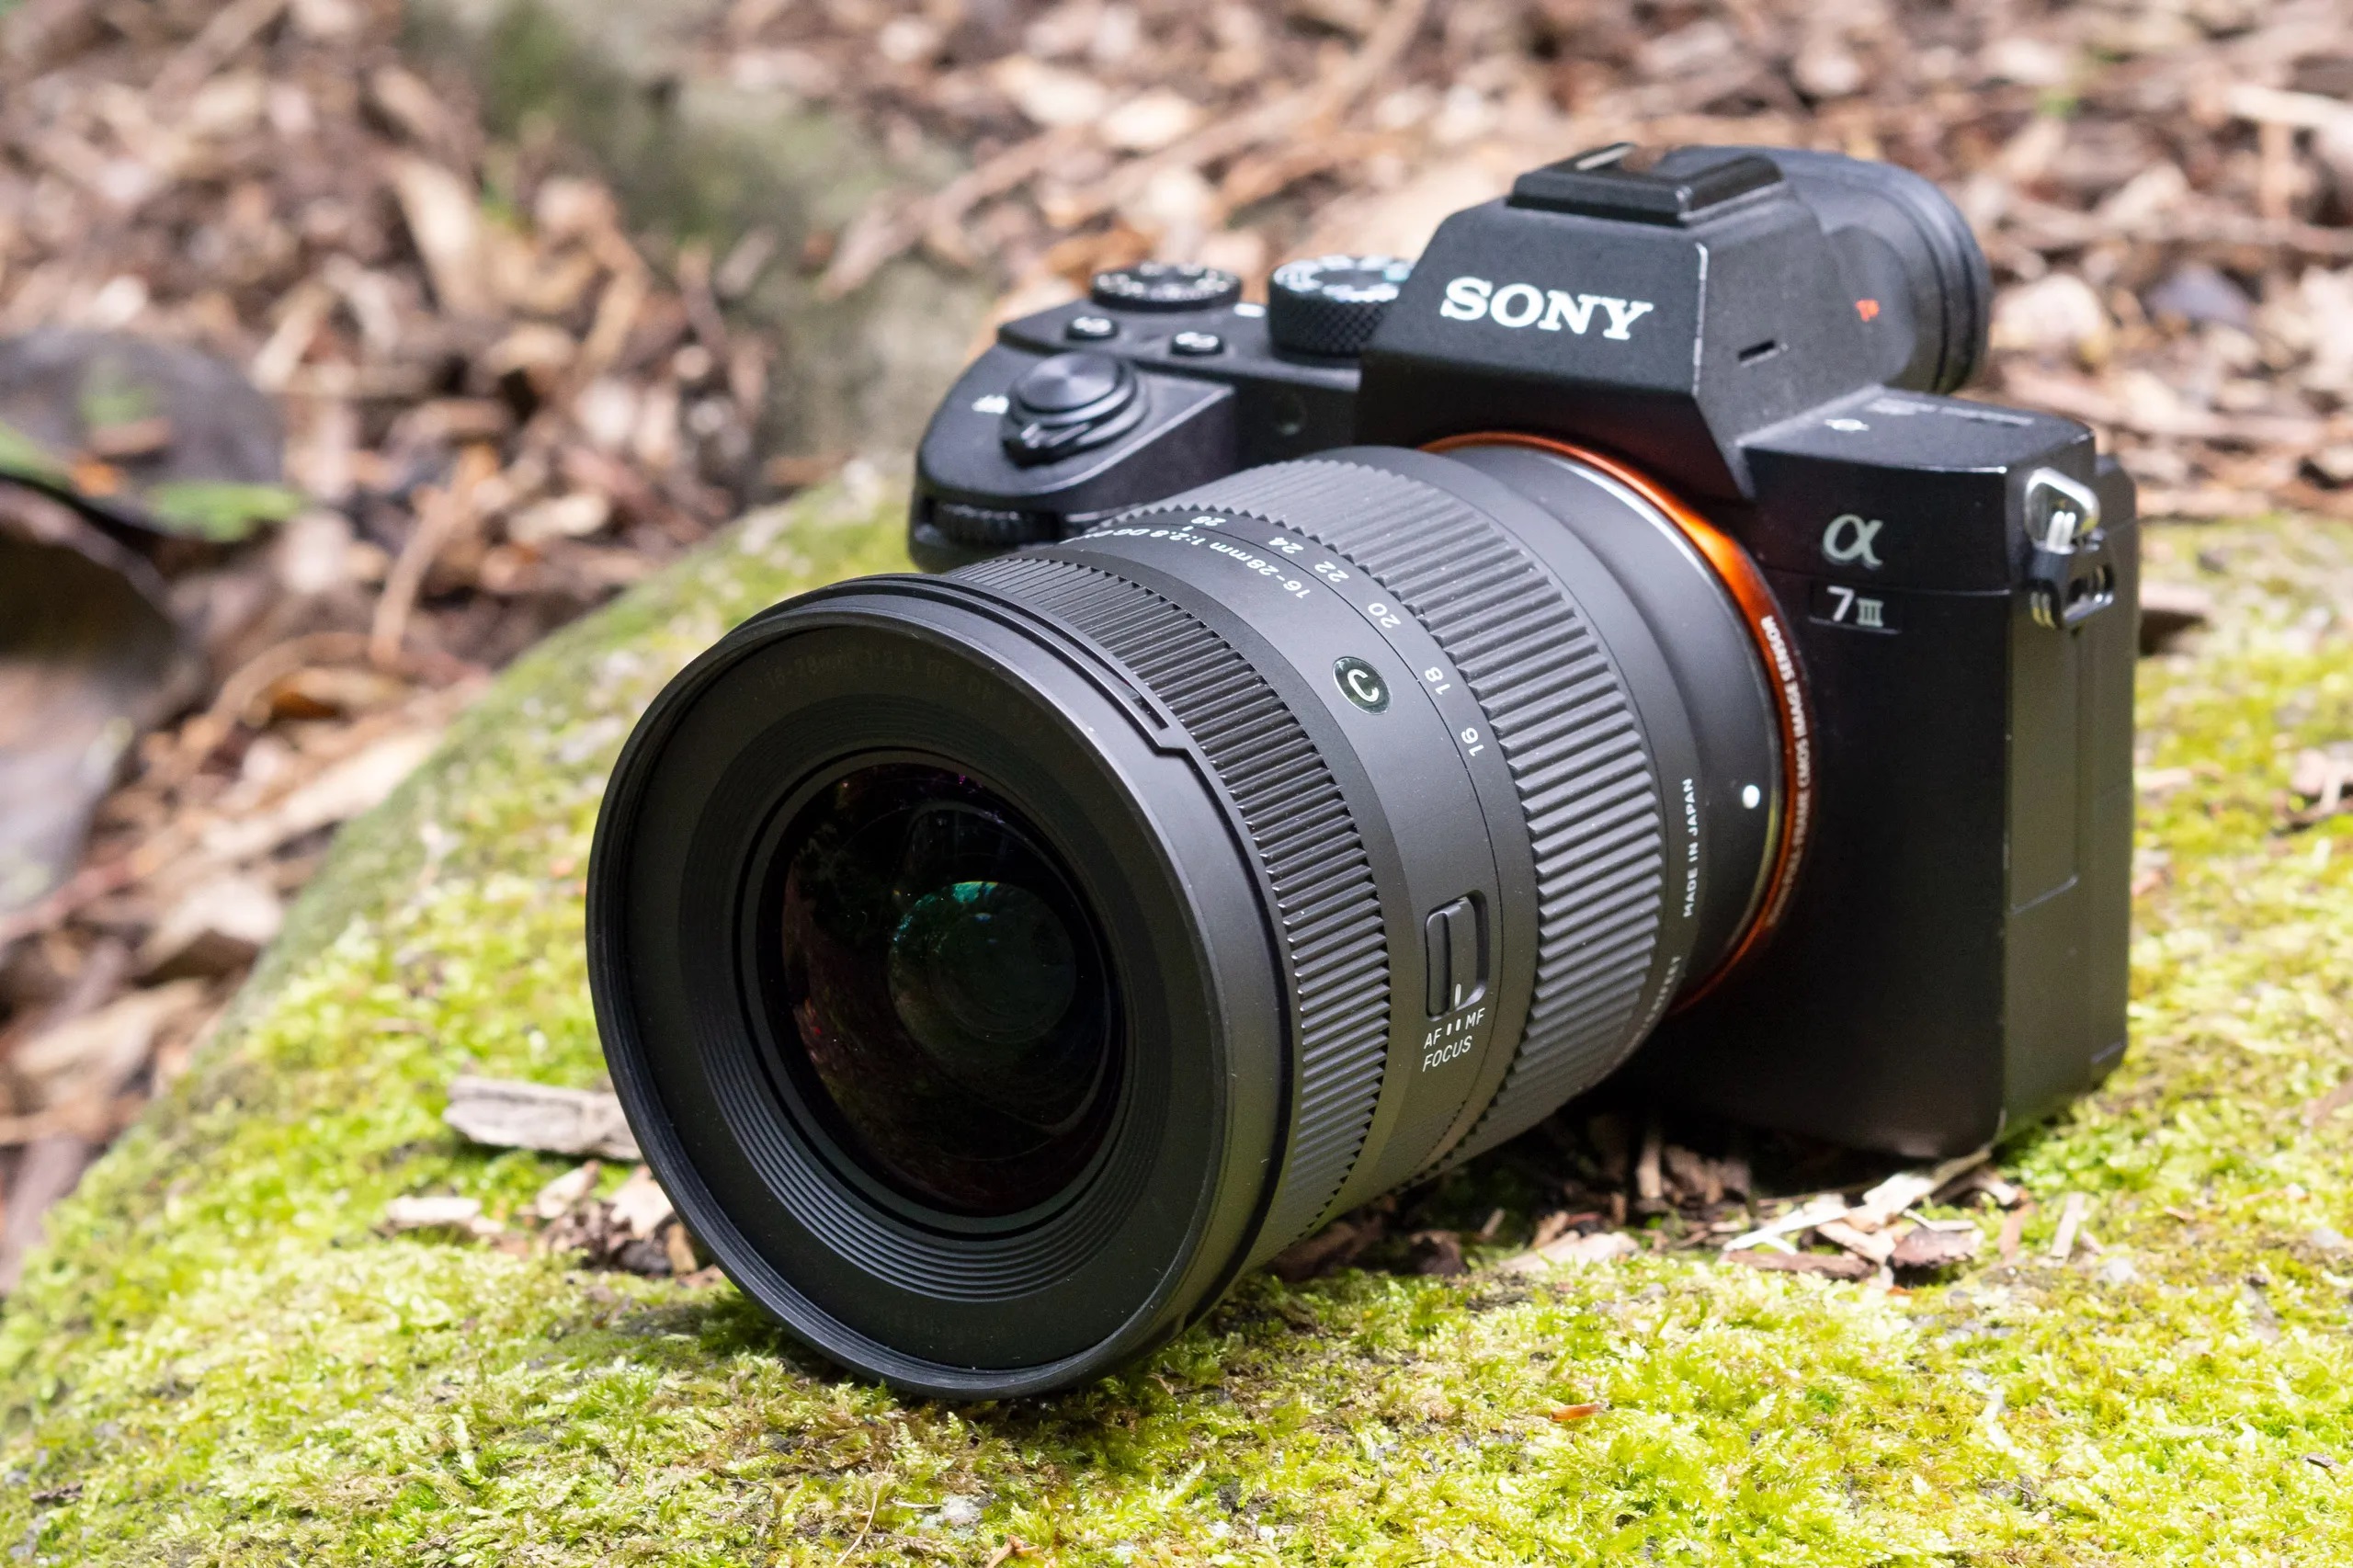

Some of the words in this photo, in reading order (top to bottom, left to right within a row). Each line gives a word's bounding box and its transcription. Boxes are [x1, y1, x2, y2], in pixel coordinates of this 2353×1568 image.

[1439, 276, 1654, 341] SONY
[1190, 516, 1227, 528] 28
[1267, 537, 1304, 554] 24
[1209, 541, 1311, 599] 16-28mm
[1314, 561, 1350, 583] 22
[1367, 602, 1402, 629] 20
[1424, 665, 1451, 696] 18
[1461, 727, 1484, 757] 16
[1681, 777, 1699, 837] JAPAN
[1688, 841, 1699, 864] IN
[1683, 868, 1699, 917] MADE
[1423, 1026, 1444, 1050] AF
[1464, 1006, 1487, 1030] MF
[1422, 1035, 1473, 1073] FOCUS
